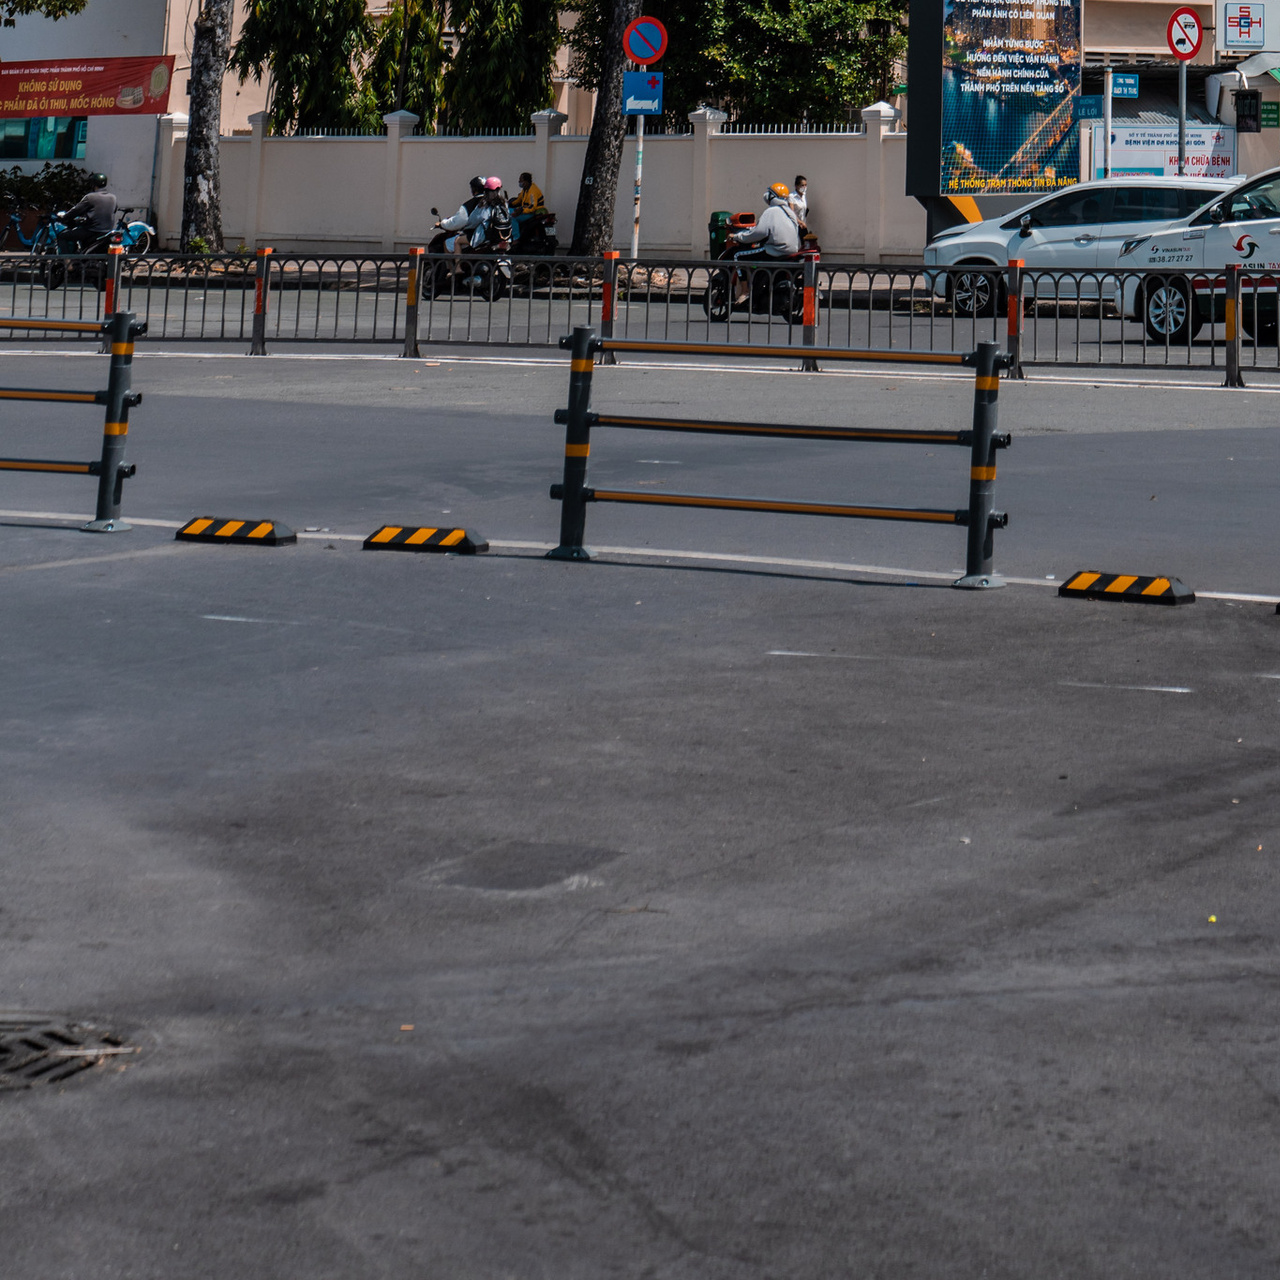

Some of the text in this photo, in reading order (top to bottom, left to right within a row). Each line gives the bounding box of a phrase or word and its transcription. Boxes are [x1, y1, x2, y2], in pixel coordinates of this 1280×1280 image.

[972, 6, 991, 17] PHẢN
[1008, 9, 1018, 19] CÓ
[1020, 9, 1034, 19] LIÊN
[1036, 11, 1055, 20] QUAN
[1005, 40, 1024, 48] TỪNG
[1025, 40, 1044, 48] BƯỚC
[967, 51, 1059, 65] HƯỚNG ĐẾN VIỆC VẬN HÀNH
[977, 66, 1049, 78] NỀN HÀNH CHÍNH CỦA
[19, 77, 82, 94] KHÔNG SỬ DỤNG
[960, 81, 1064, 93] THÀNH PHỐ TRÊN NỀN TẢNG SỐ
[4, 95, 25, 110] PHẨM
[27, 98, 38, 110] ĐÃ
[40, 97, 48, 109] ÔI
[50, 99, 68, 111] THIU,
[70, 94, 89, 109] MỐC
[91, 94, 115, 108] HỎNG
[1087, 108, 1097, 117] LỢI
[1169, 154, 1231, 167] KHM CHỮA BỆNH
[949, 178, 959, 190] HỆ
[960, 177, 985, 189] THỐNG
[987, 179, 1006, 189] TRẠM
[1008, 177, 1032, 188] THÔNG
[1034, 178, 1045, 187] TIN
